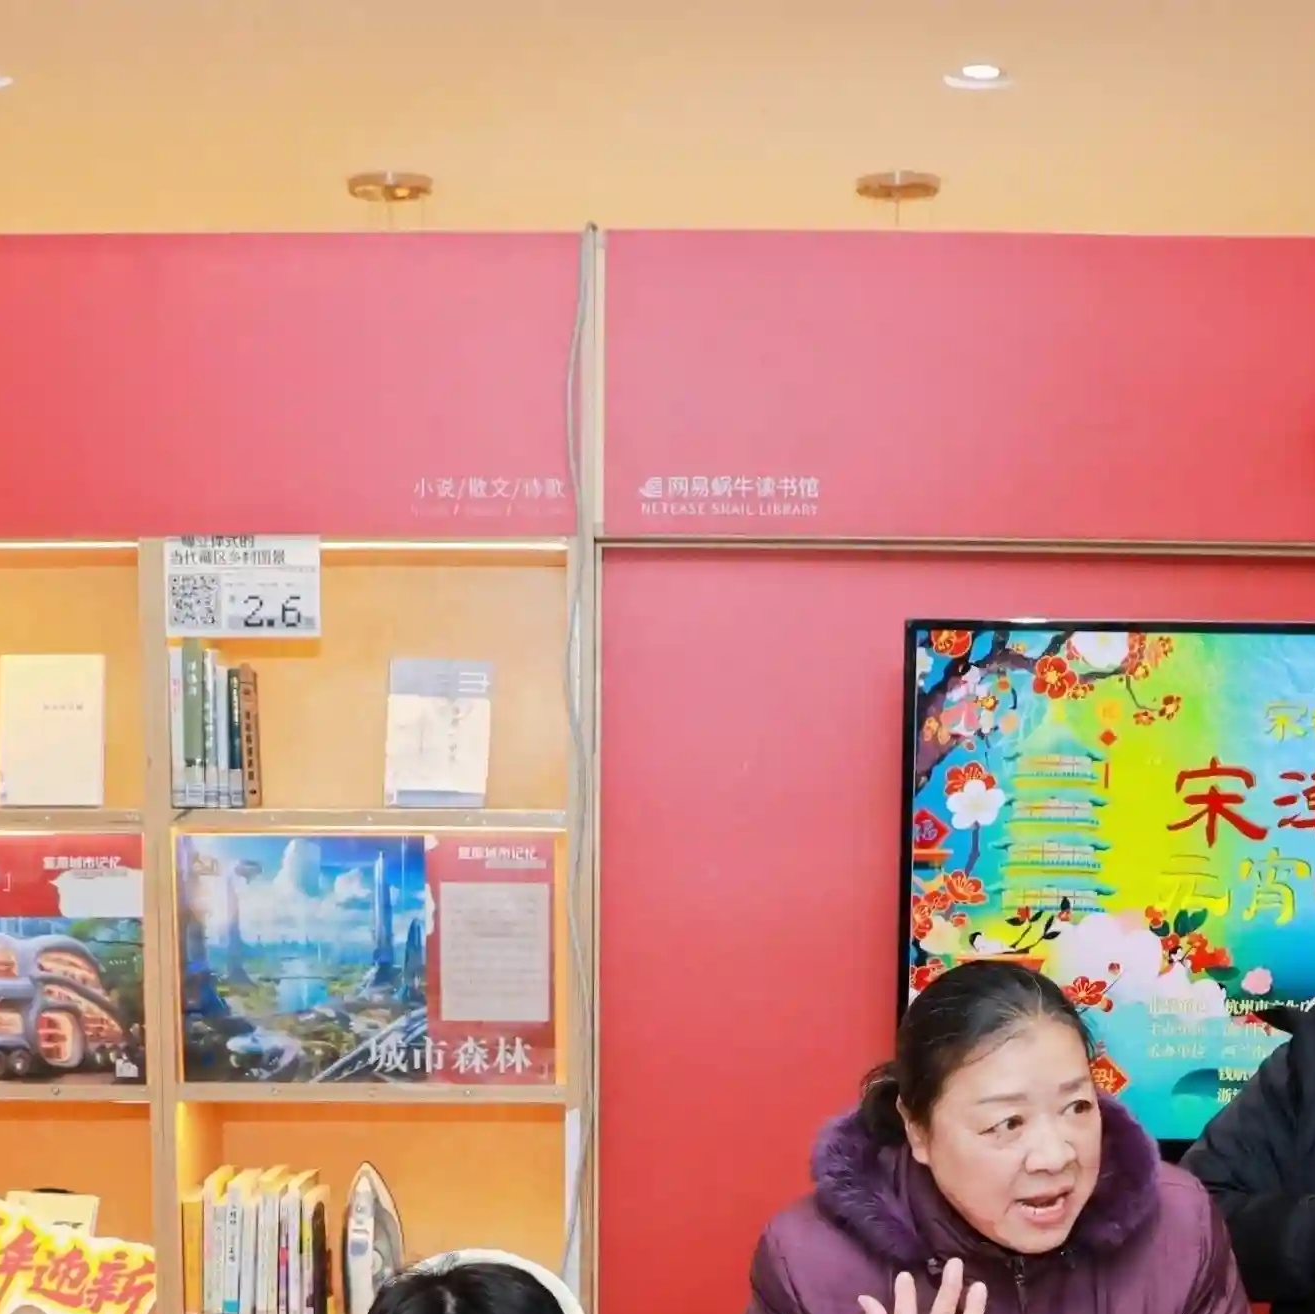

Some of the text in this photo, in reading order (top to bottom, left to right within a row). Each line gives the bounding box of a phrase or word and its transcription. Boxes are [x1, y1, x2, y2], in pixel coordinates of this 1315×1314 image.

[668, 476, 820, 498] 网易蜗牛读书馆
[641, 502, 819, 516] NETEASE SNAIL LIBRARY
[242, 595, 302, 628] 2.6
